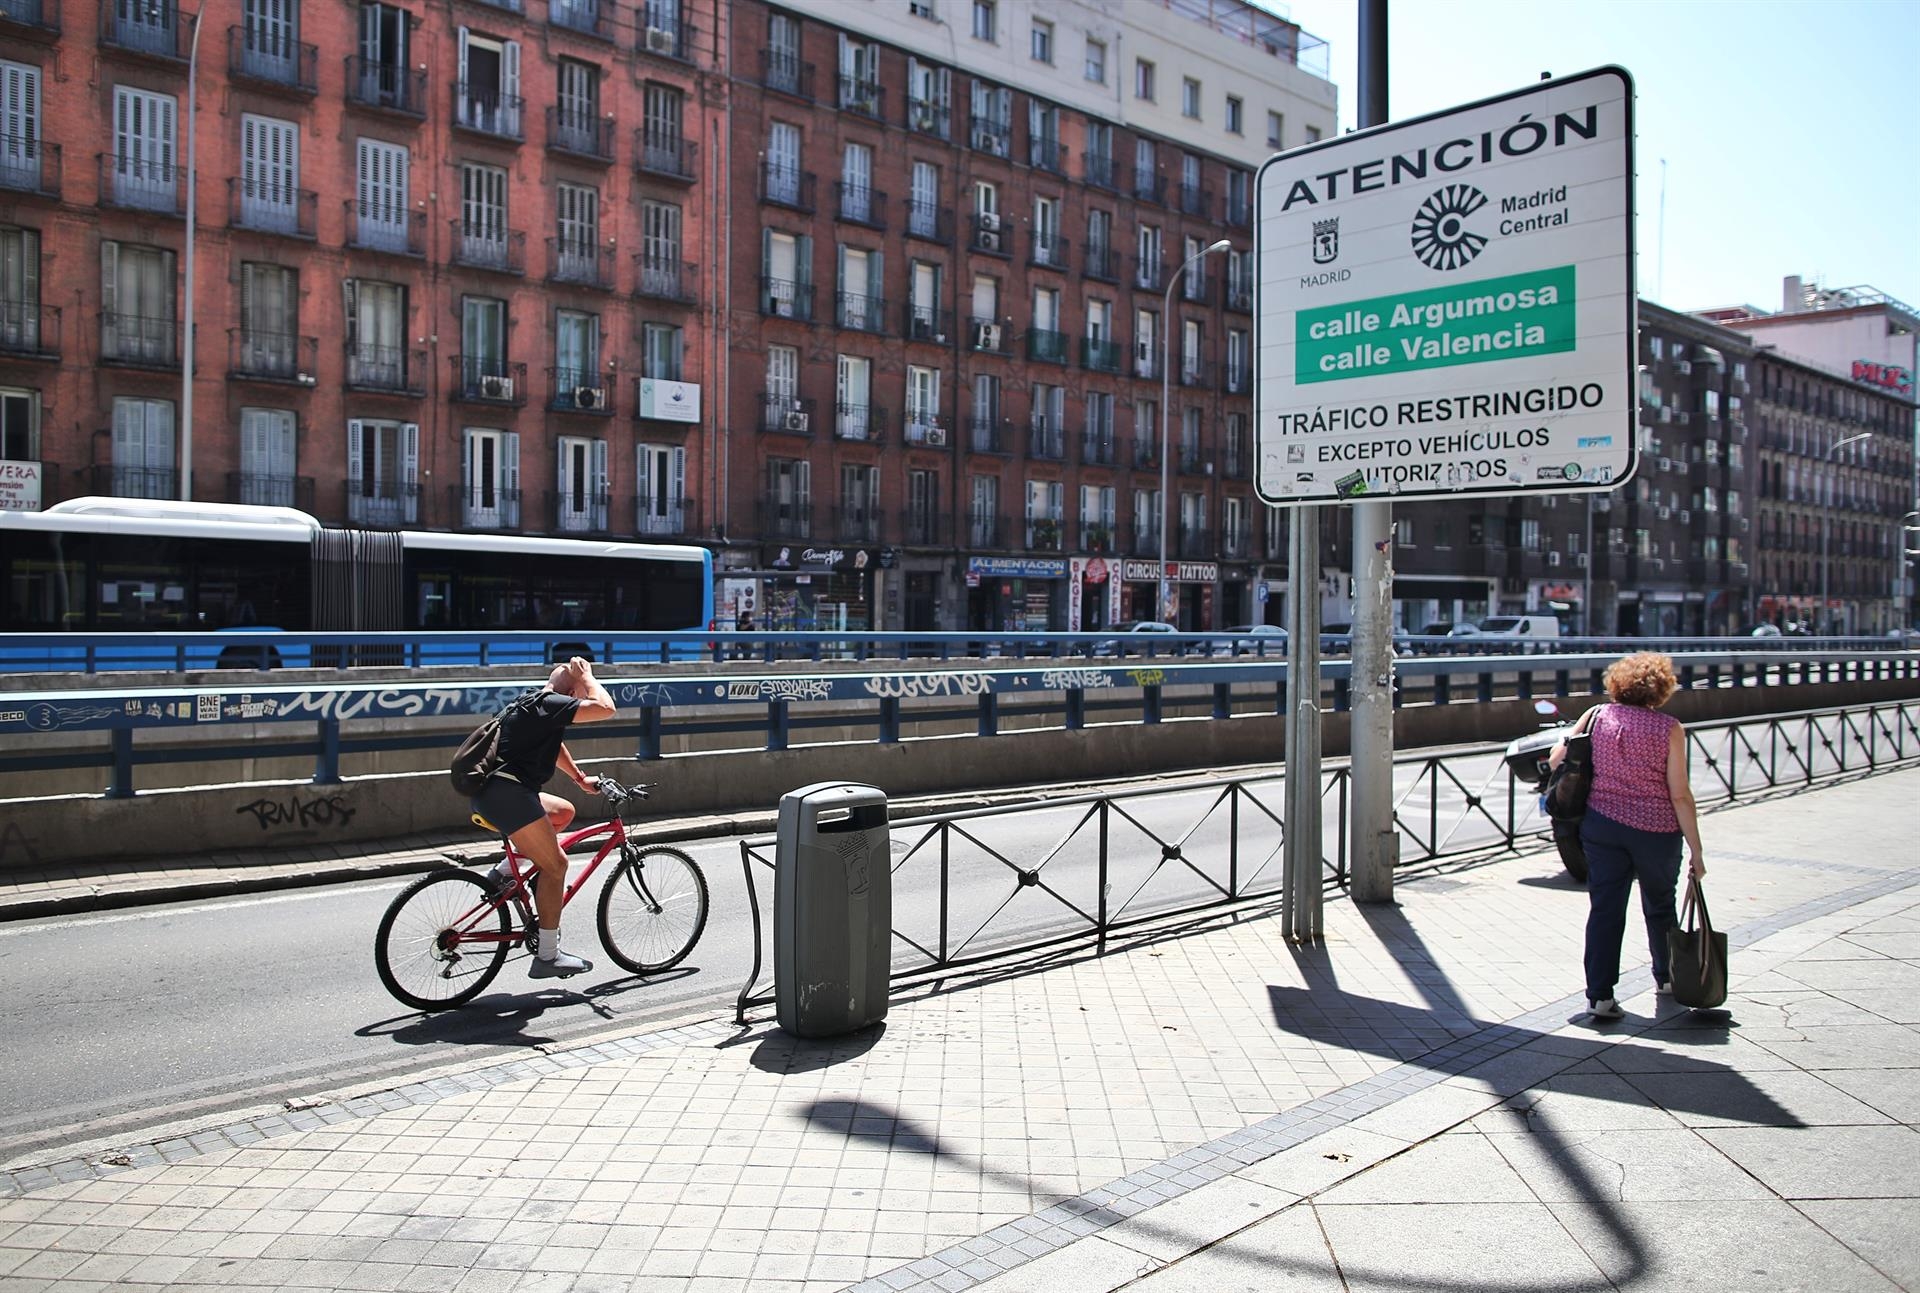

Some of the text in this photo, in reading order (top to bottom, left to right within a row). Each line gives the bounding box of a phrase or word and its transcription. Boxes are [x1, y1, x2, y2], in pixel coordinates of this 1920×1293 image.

[1281, 105, 1597, 212] ATENCIÓN
[1501, 186, 1567, 214] Madrid
[1500, 209, 1569, 236] Central
[1301, 269, 1351, 289] MADRID
[1309, 284, 1559, 340] calle Argumosa
[1319, 322, 1545, 372] calle Valencia
[1278, 383, 1604, 435] TRÁFICO RESTRINGIDO
[1318, 438, 1412, 463] EXCEPTO
[1418, 427, 1550, 456] VEHÍCULOS
[1355, 458, 1507, 485] UTORIZOS
[1126, 563, 1161, 579] CIRCUS
[1181, 564, 1217, 580] TATTOO
[1072, 561, 1080, 631] BAGELS
[200, 695, 219, 706] BNE
[730, 684, 758, 696] KOKO
[0, 709, 24, 721] eco
